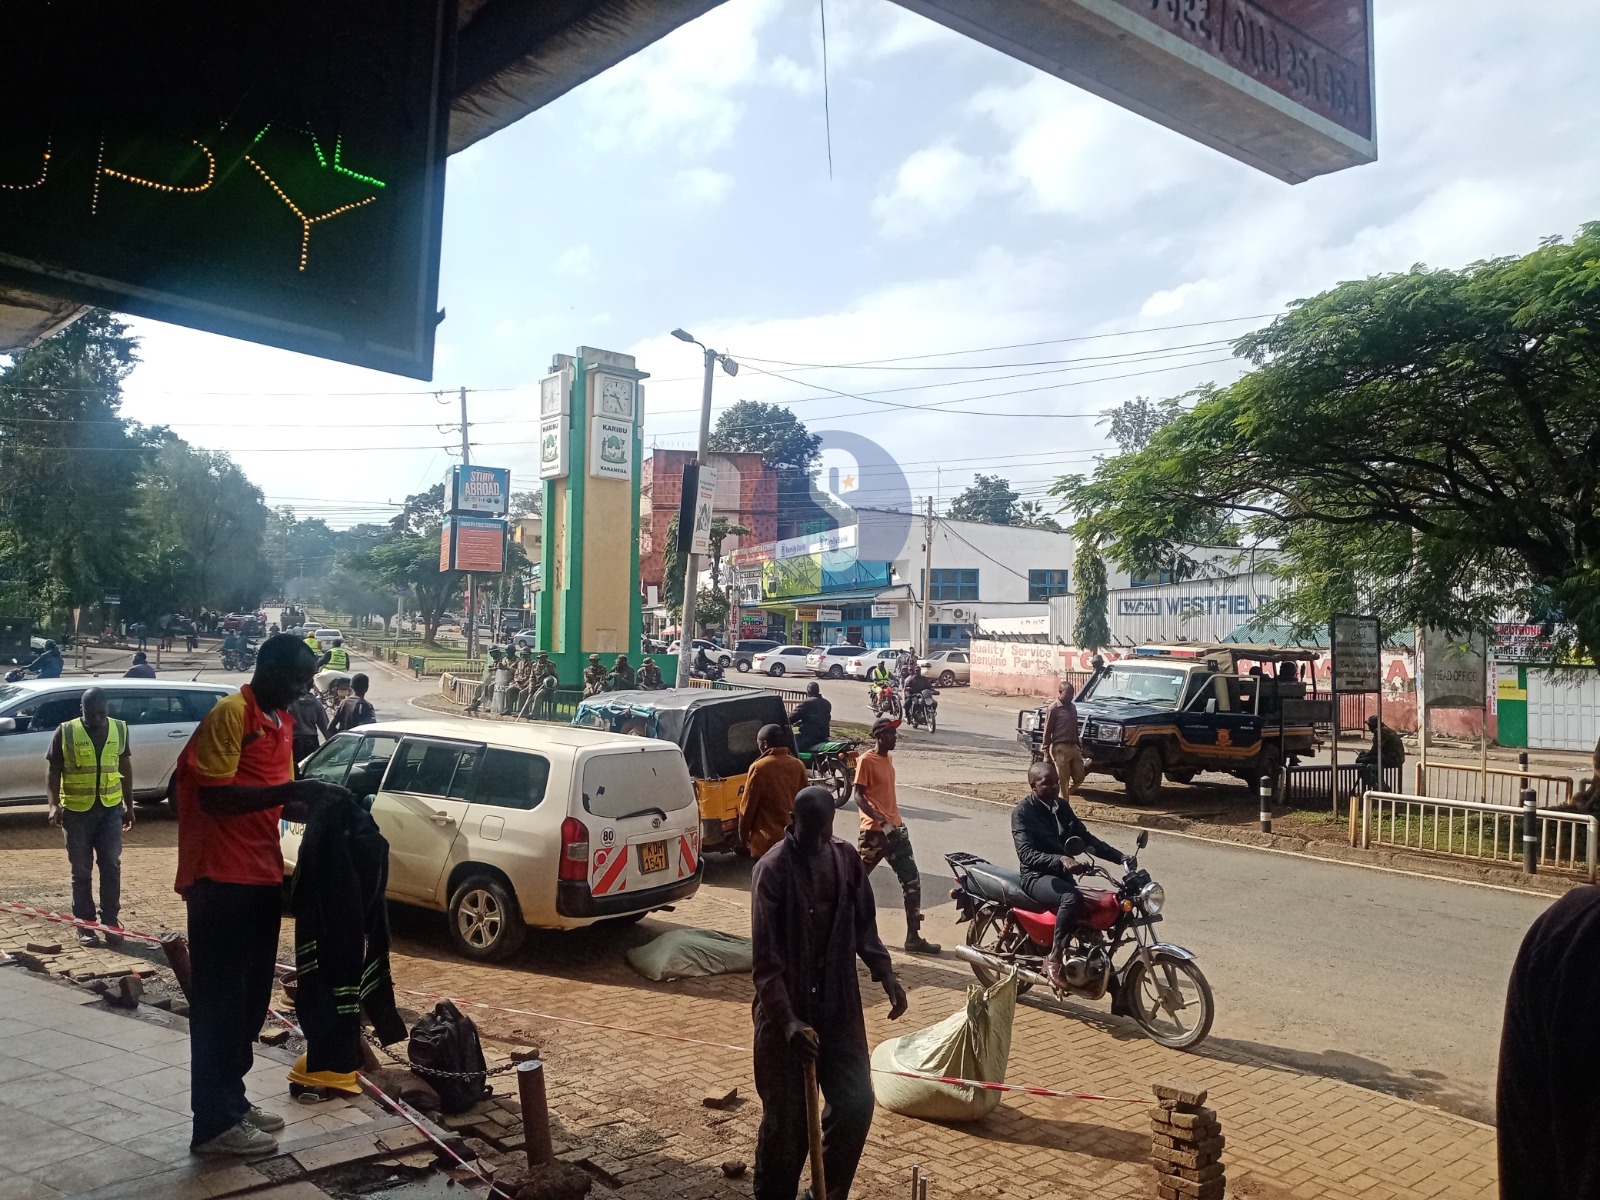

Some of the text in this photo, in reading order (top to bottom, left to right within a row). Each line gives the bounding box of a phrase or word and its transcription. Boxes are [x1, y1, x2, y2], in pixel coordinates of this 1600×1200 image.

[602, 424, 628, 434] KARIBU
[600, 465, 628, 474] KAKAMEGA
[470, 471, 495, 482] STUDY
[464, 482, 500, 496] ABROAD
[971, 642, 1052, 658] Quality Service
[971, 653, 1050, 669] Genuine Parts
[1453, 670, 1477, 682] OFFICE
[603, 830, 614, 841] 80
[647, 842, 663, 855] KDH
[645, 855, 664, 871] 154T
